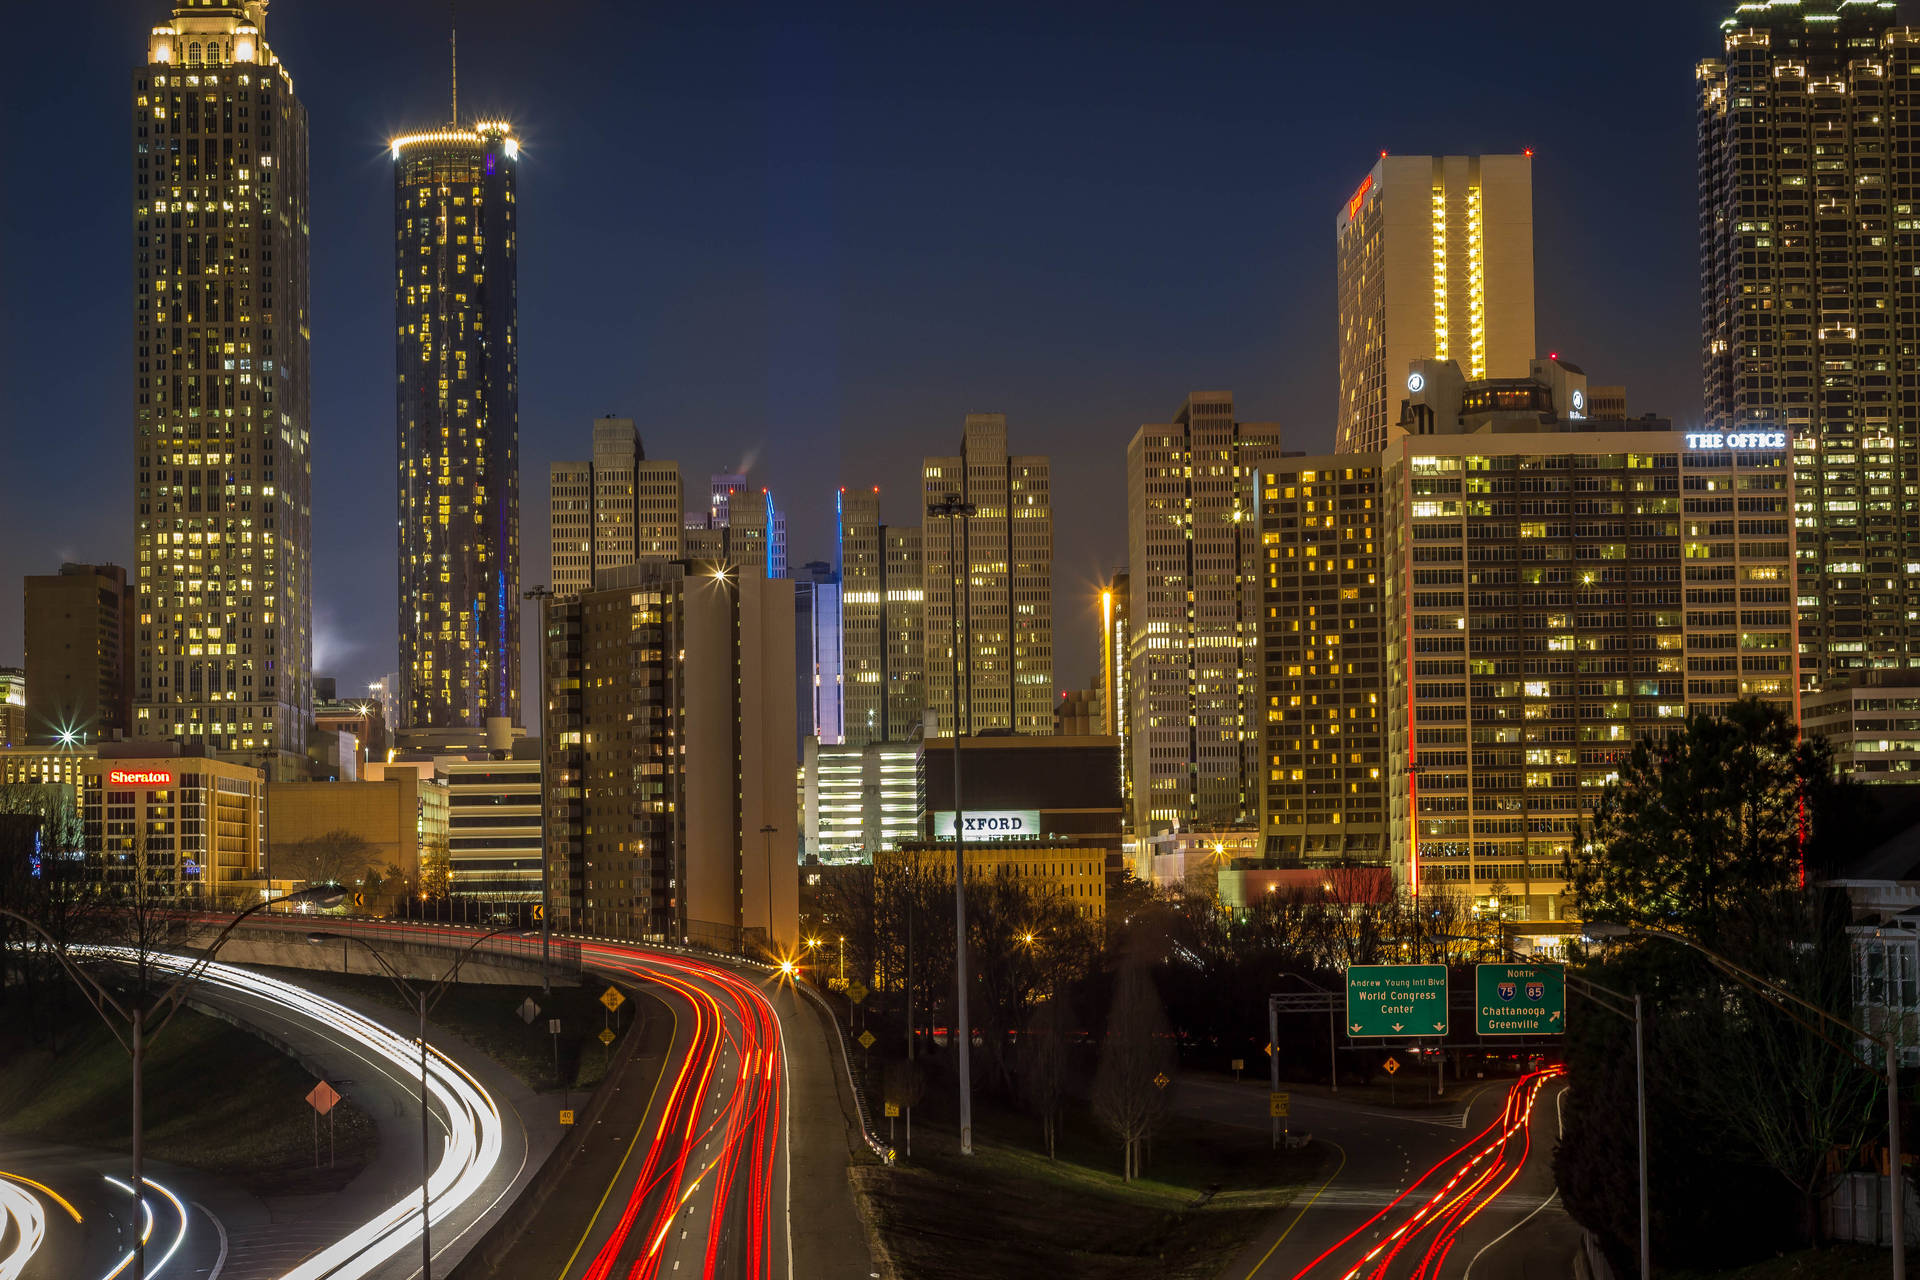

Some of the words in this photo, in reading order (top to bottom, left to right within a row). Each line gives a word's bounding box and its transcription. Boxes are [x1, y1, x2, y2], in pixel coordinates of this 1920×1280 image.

[1686, 434, 1724, 448] THE
[1726, 433, 1785, 448] OFFICE
[111, 771, 170, 783] Sheraton
[1507, 969, 1535, 978] NORTH
[1350, 979, 1381, 988] Andrew
[1385, 979, 1410, 988] Young
[1412, 978, 1426, 987] Intl
[1428, 978, 1445, 986] Blvd
[1359, 991, 1386, 1000] World
[1390, 991, 1436, 1002] Congress
[1500, 987, 1514, 997] 75
[1528, 987, 1542, 997] 85
[1381, 1004, 1414, 1014] Center
[1482, 1006, 1545, 1017] Chattanooga
[1488, 1019, 1539, 1029] Greenville
